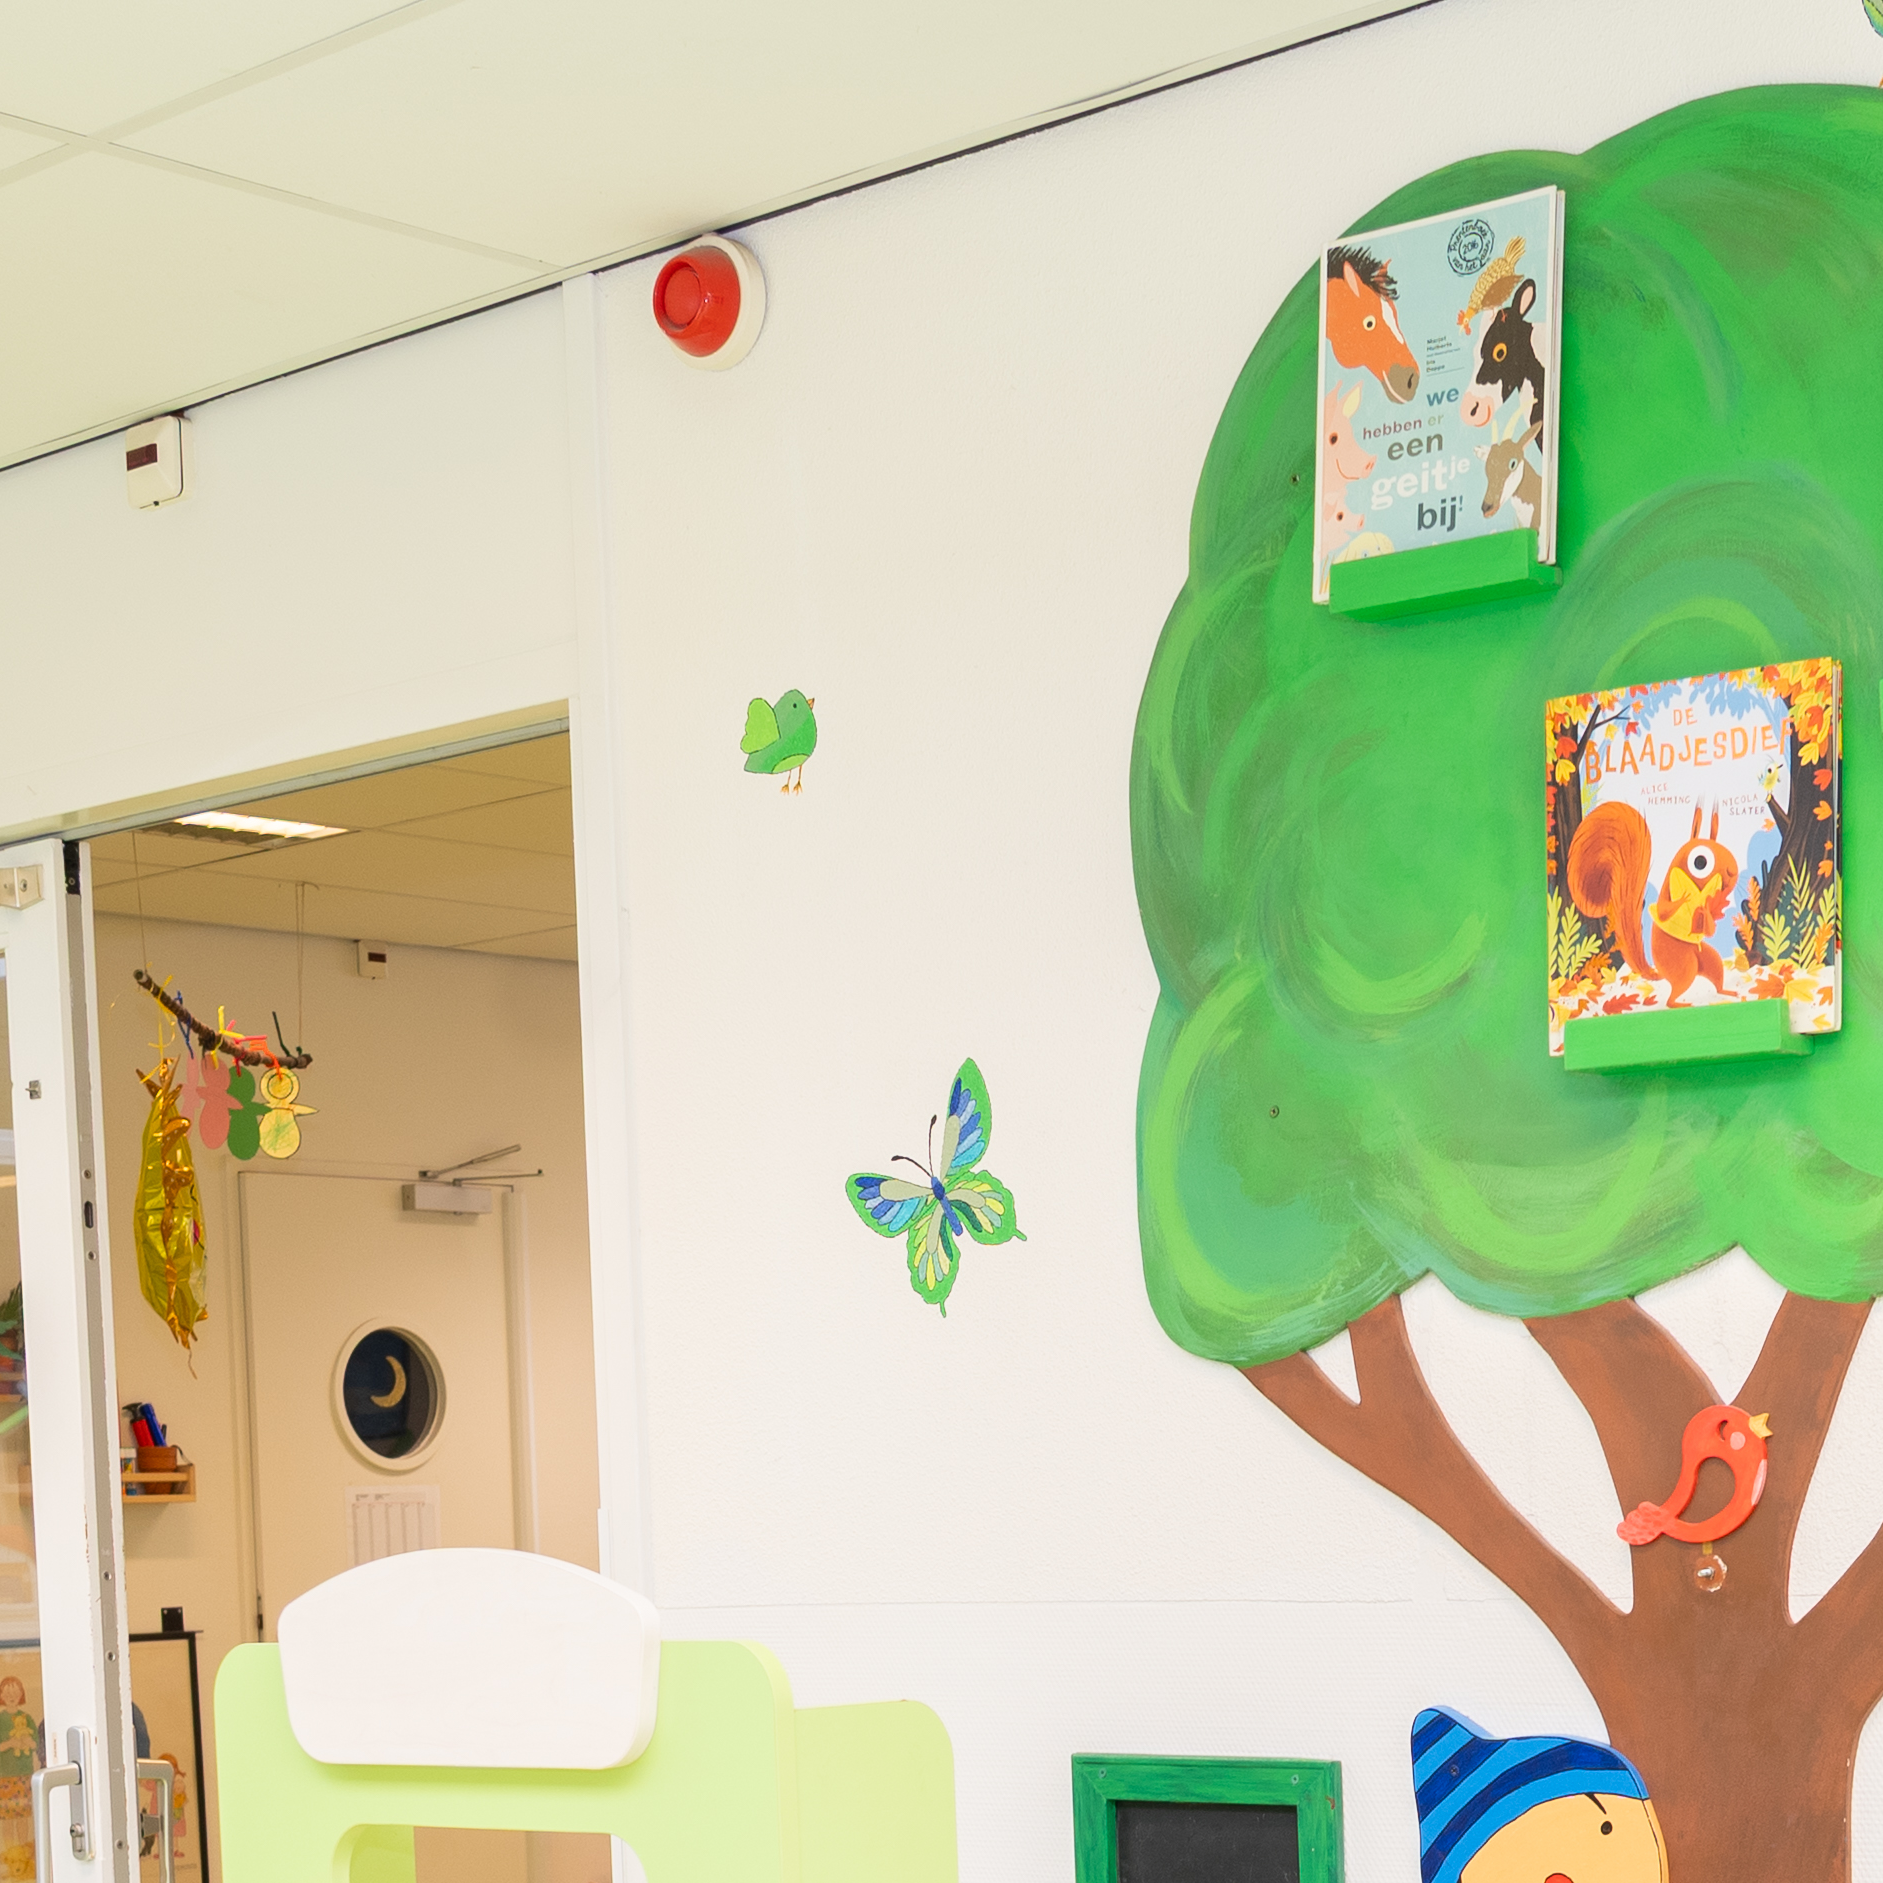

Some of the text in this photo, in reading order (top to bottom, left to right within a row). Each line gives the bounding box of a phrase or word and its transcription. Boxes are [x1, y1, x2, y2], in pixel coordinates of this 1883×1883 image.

[1426, 387, 1459, 407] we
[1362, 414, 1444, 440] hebben er
[1387, 433, 1444, 461] een
[1370, 455, 1471, 511] geitje
[1417, 494, 1464, 532] bij!
[1673, 707, 1698, 726] DE
[1585, 717, 1793, 784] BLAADJESDIEF
[1641, 782, 1669, 796] ALICE
[1648, 795, 1692, 806] HEMMING
[1722, 793, 1759, 806] NICOLA
[1729, 806, 1766, 816] SLATER
